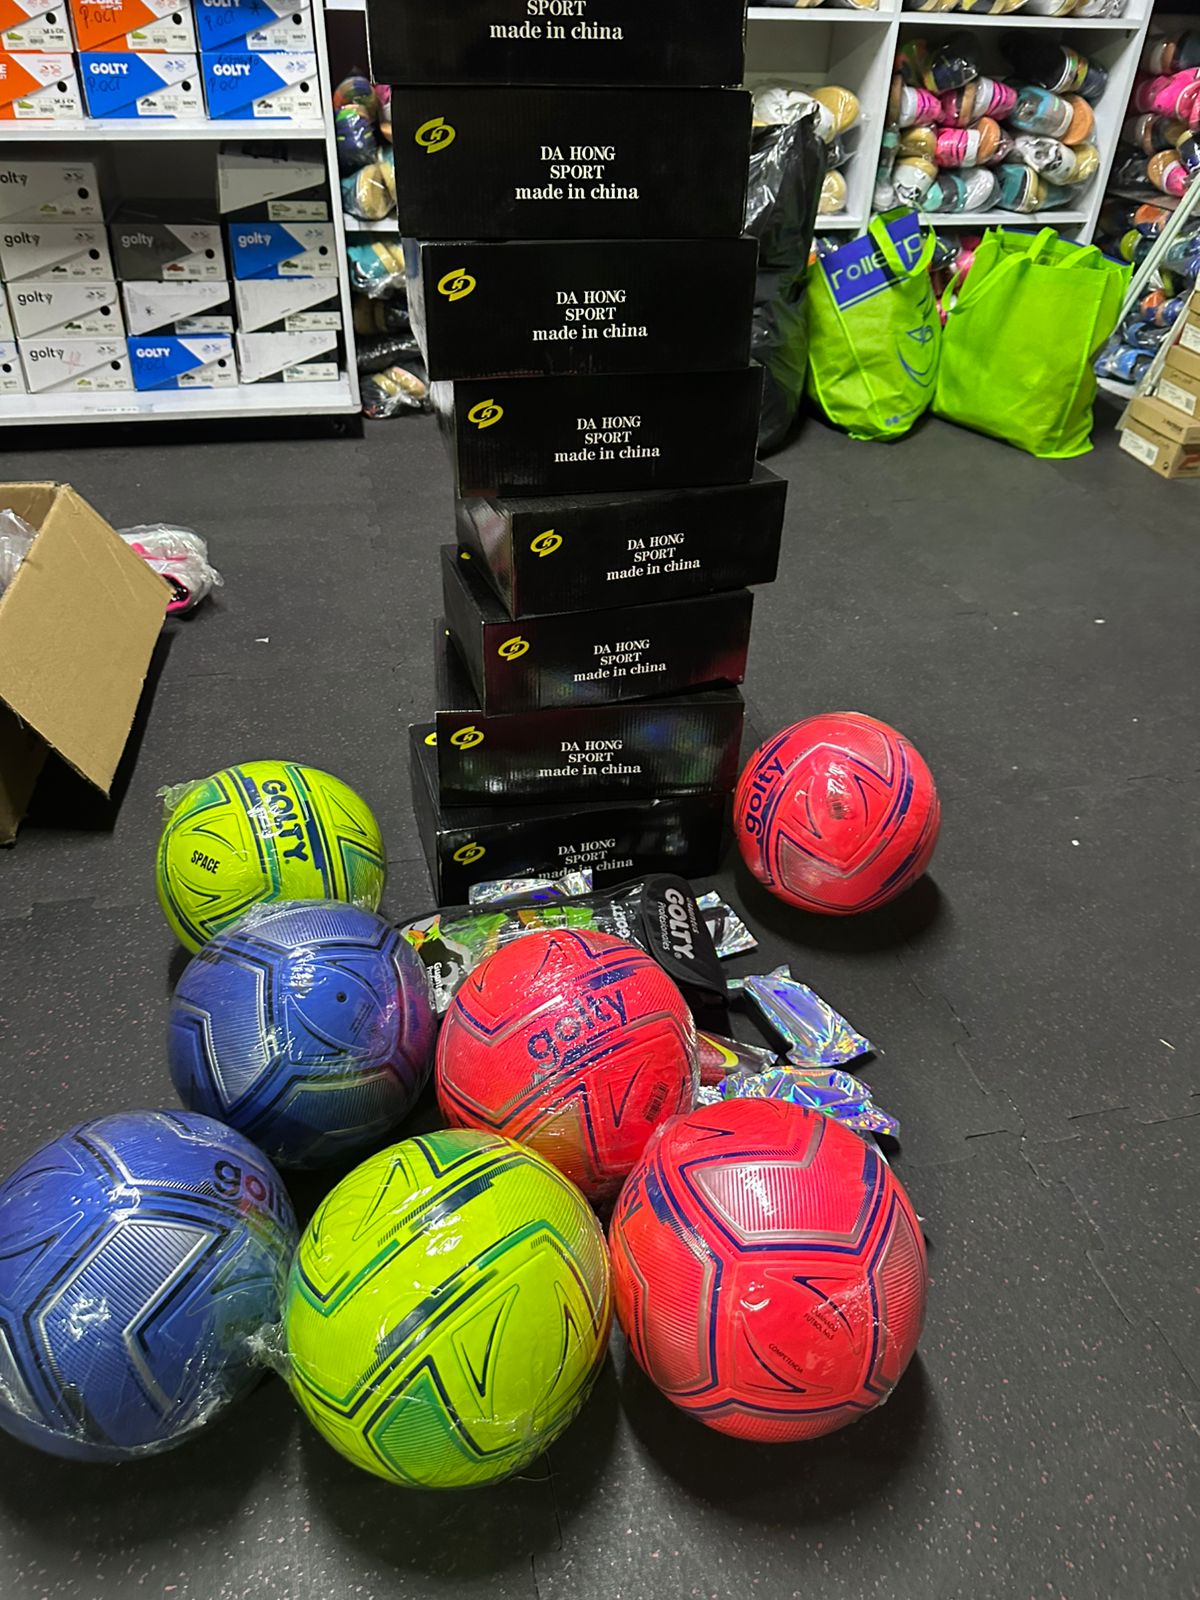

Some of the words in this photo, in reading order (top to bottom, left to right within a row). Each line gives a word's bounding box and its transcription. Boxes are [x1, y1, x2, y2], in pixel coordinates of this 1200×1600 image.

[527, 0, 586, 16] SPORT
[490, 20, 541, 39] made
[546, 22, 566, 39] in
[571, 21, 624, 40] china
[90, 62, 129, 75] GOLTY
[213, 63, 250, 76] GOLTY
[541, 146, 564, 160] DA
[570, 146, 616, 161] HONG
[0, 170, 28, 187] olty
[550, 165, 605, 179] SPORT
[515, 184, 563, 200] made
[568, 183, 586, 199] in
[590, 183, 639, 199] china
[4, 231, 41, 248] golty
[121, 232, 154, 248] golty
[237, 232, 272, 248] golty
[17, 290, 53, 306] golty
[556, 291, 578, 305] DA
[584, 290, 626, 304] HONG
[565, 307, 616, 321] SPORT
[533, 325, 578, 341] made
[582, 324, 598, 339] in
[603, 323, 648, 338] china
[29, 347, 64, 362] golty
[136, 347, 170, 358] GOLTY
[577, 418, 597, 430] DA
[602, 416, 641, 429] HONG
[585, 431, 632, 444] SPORT
[555, 448, 596, 462] made
[599, 447, 615, 460] in
[619, 445, 660, 459] china
[627, 538, 645, 550] DA
[650, 533, 684, 547] HONG
[634, 547, 676, 562] SPORT
[607, 565, 644, 581] made
[647, 563, 660, 575] in
[664, 557, 700, 572] china
[594, 644, 611, 655] DA
[615, 639, 650, 652] HONG
[600, 652, 642, 666] SPORT
[573, 668, 610, 682] made
[613, 666, 626, 677] in
[630, 662, 666, 674] china
[561, 742, 580, 752] DA
[585, 740, 623, 751] HONG
[568, 752, 614, 763] SPORT
[539, 766, 579, 778] made
[582, 764, 597, 775] in
[601, 763, 641, 774] china
[745, 757, 785, 835] golty
[262, 780, 308, 861] GOLTY
[558, 845, 576, 855] DA
[581, 839, 615, 852] HONG
[191, 850, 221, 875] SPACE
[565, 851, 605, 865] SPORT
[596, 859, 633, 871] china
[657, 900, 672, 951] Profesionales
[665, 888, 695, 960] GOLTY
[527, 989, 628, 1070] golty
[768, 1343, 804, 1374] COMPETENCIA
